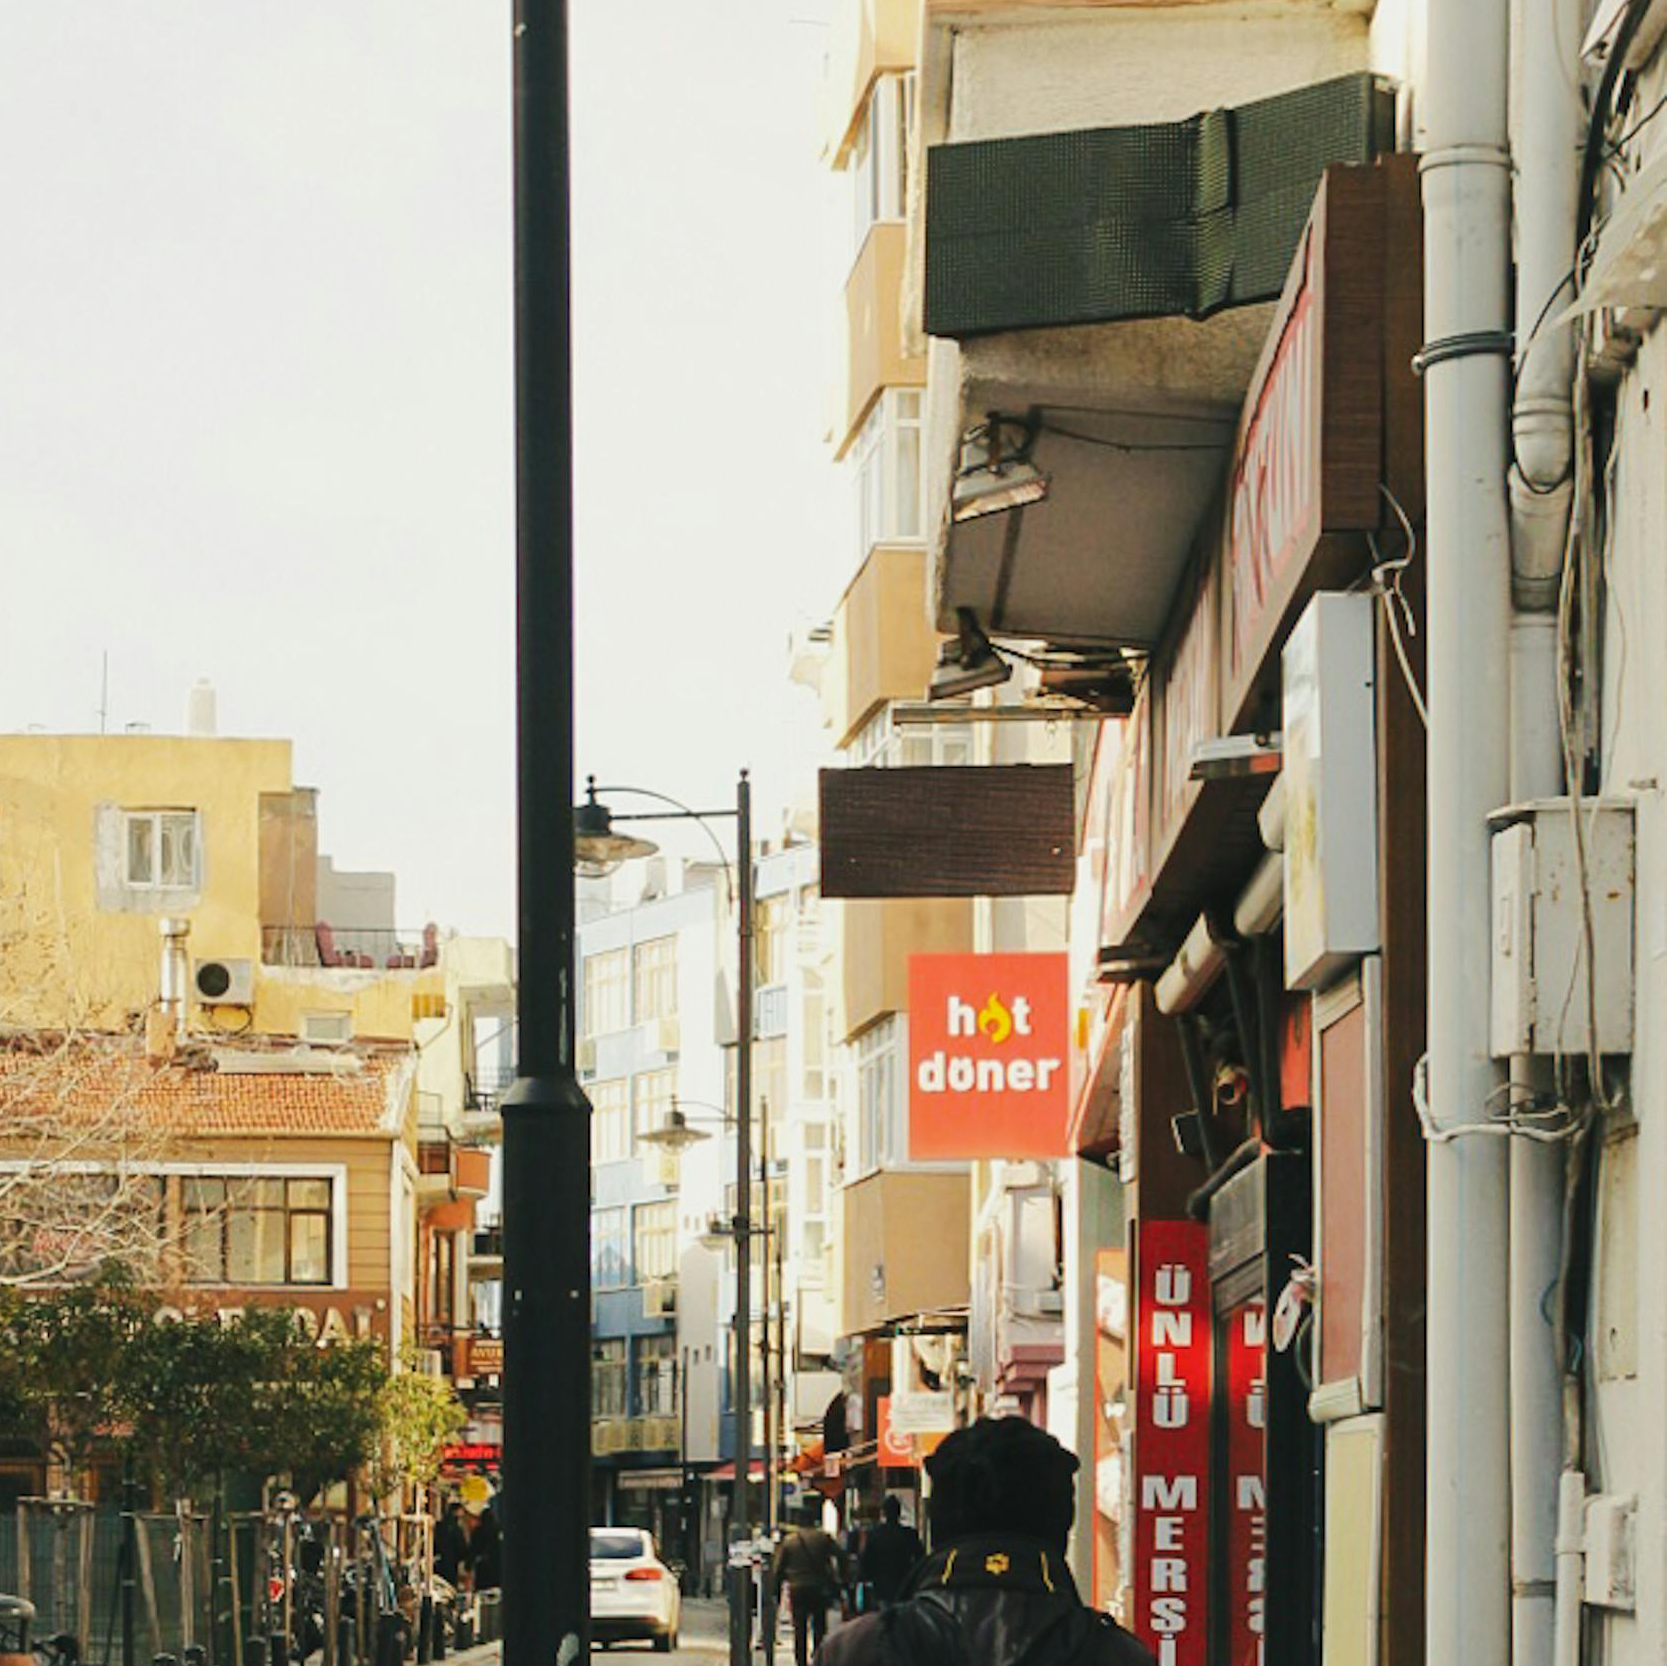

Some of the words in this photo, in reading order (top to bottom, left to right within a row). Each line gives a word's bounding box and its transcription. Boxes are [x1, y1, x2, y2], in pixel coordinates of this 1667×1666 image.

[947, 992, 1032, 1043] hot
[918, 1050, 1061, 1092] döner
[1150, 1263, 1192, 1429] ÜNLÜ
